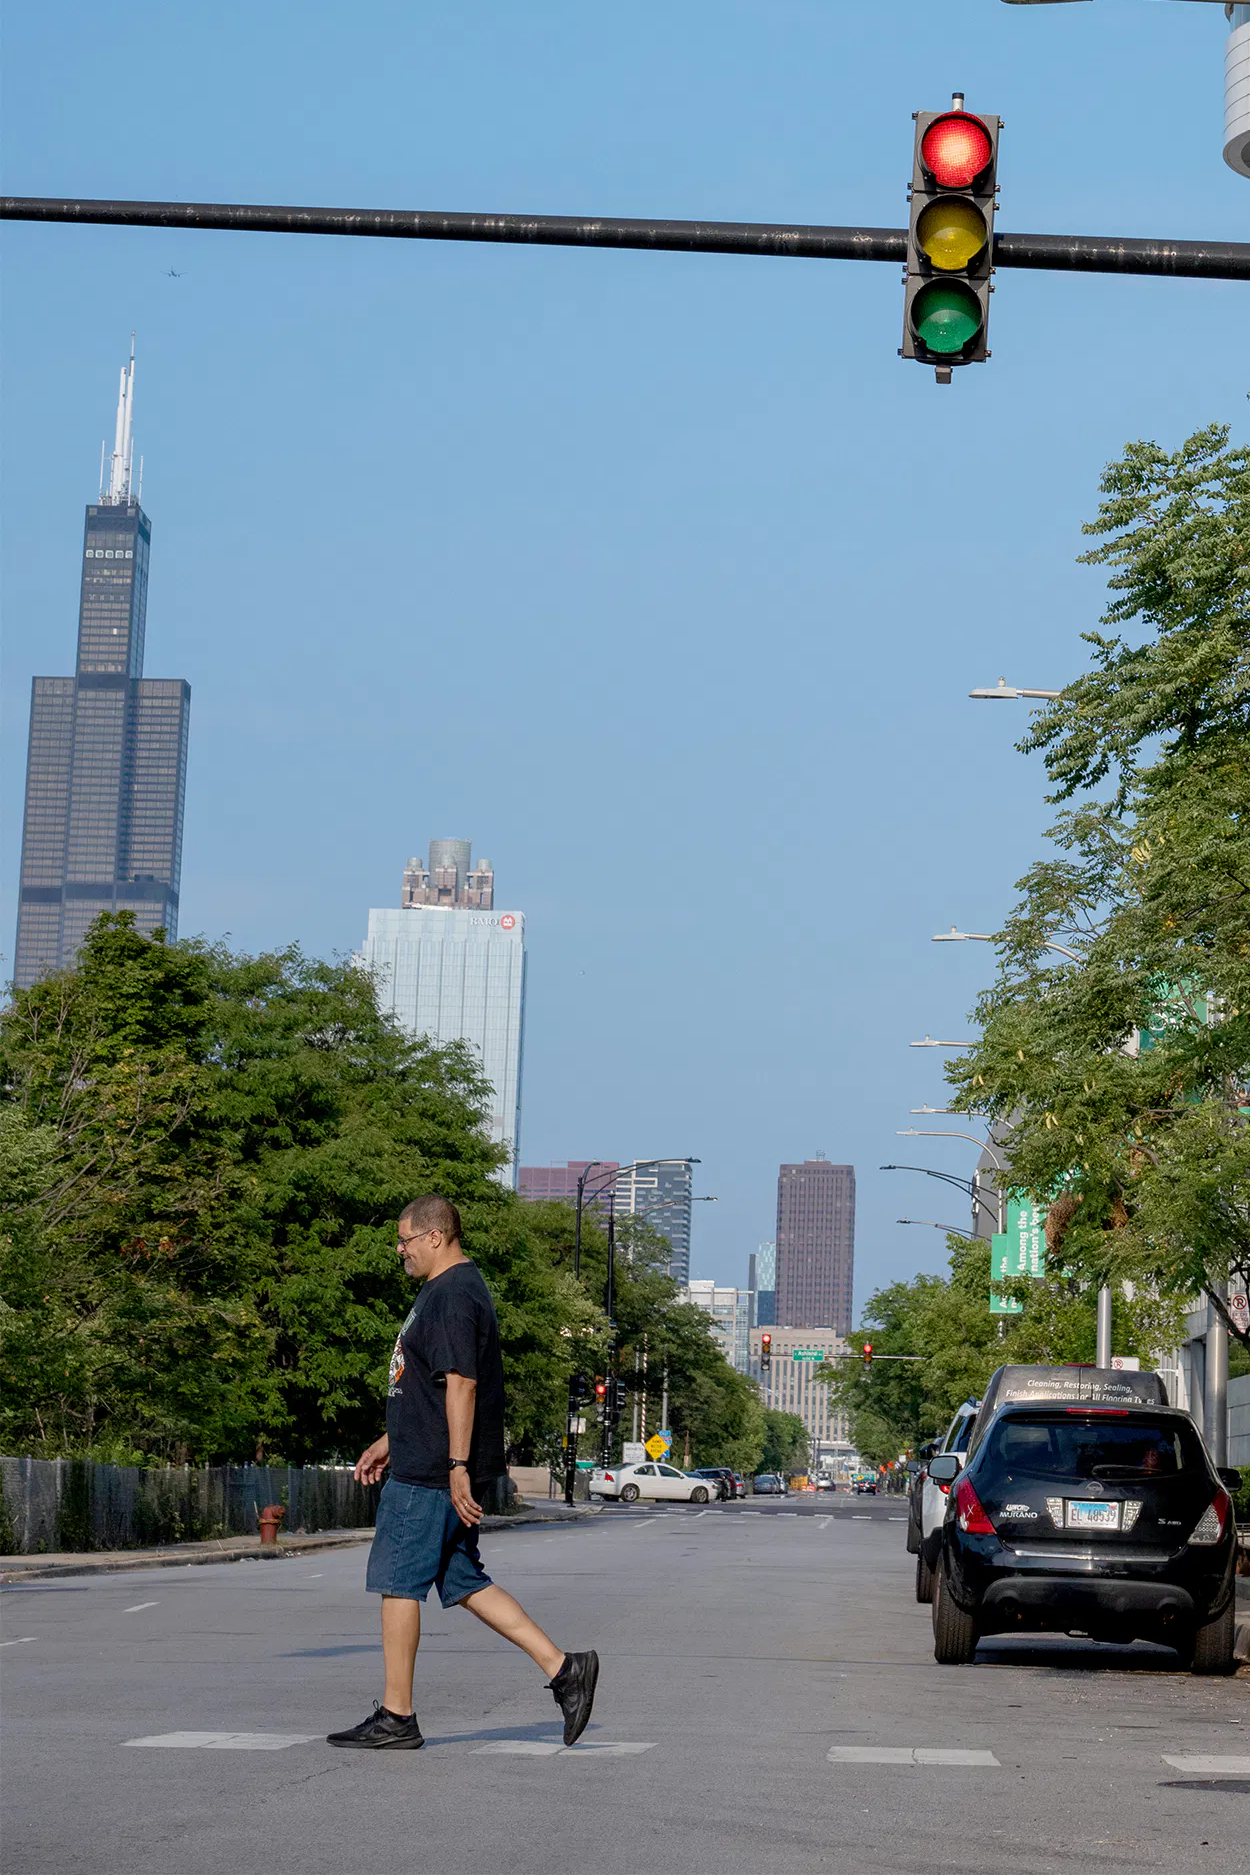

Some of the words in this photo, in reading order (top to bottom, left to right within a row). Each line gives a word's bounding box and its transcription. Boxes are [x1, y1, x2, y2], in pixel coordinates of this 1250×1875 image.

[470, 917, 498, 927] BMO
[1018, 1210, 1028, 1230] the
[1017, 1231, 1029, 1271] Among
[1029, 1227, 1039, 1272] nation's
[1027, 1379, 1062, 1390] Cleaning,
[1103, 1383, 1133, 1394] Sealing,
[1006, 1389, 1028, 1397] Finish
[1134, 1396, 1155, 1405] Tyes
[999, 1511, 1038, 1519] MURANO
